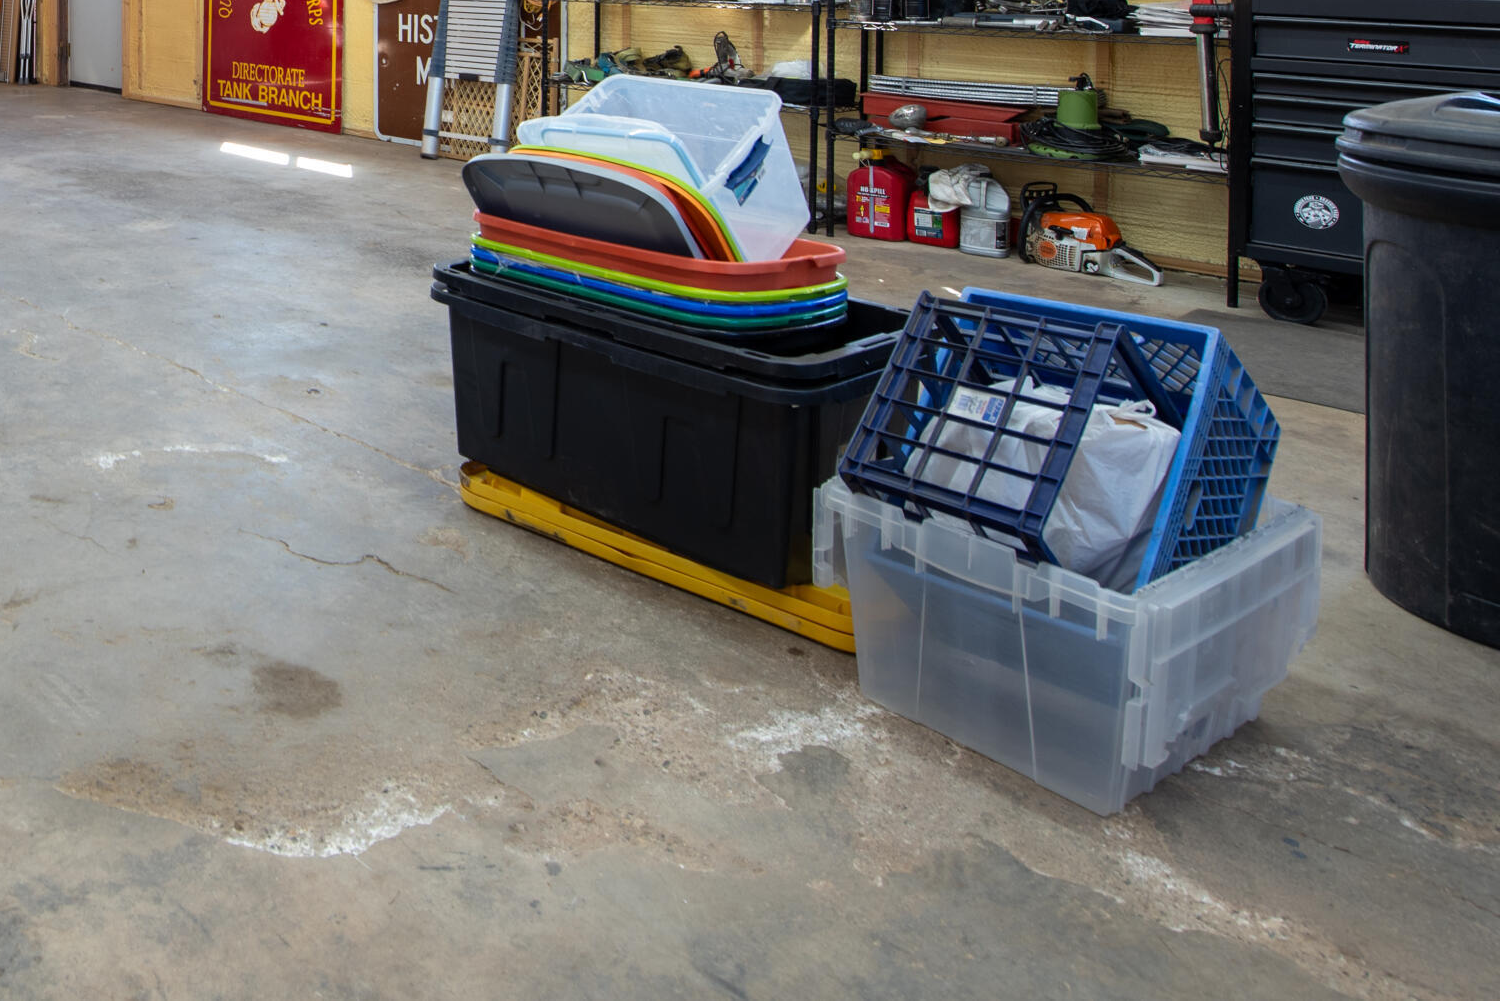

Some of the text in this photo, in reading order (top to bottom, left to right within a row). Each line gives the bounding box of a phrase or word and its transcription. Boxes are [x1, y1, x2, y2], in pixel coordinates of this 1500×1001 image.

[231, 61, 305, 88] DIRECTORATE
[217, 79, 322, 112] TANK BRANCH
